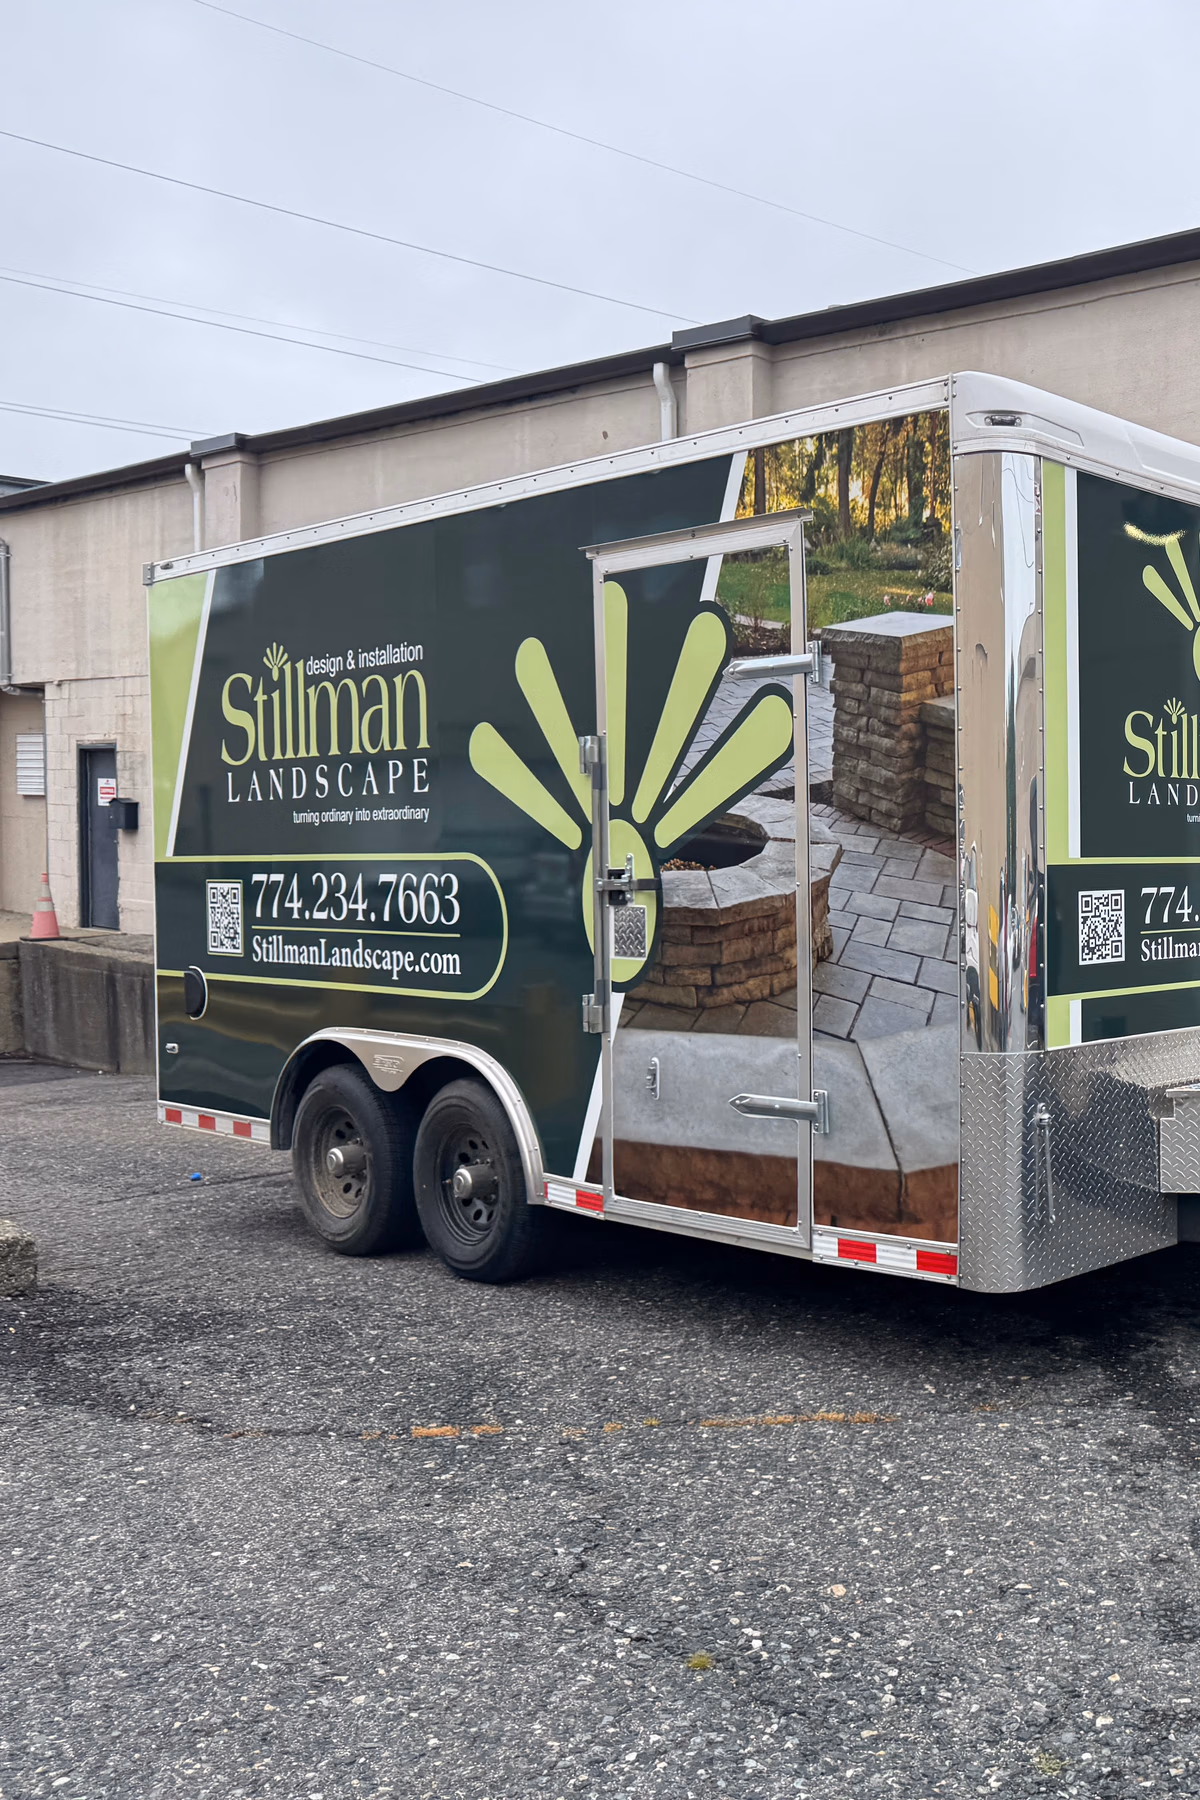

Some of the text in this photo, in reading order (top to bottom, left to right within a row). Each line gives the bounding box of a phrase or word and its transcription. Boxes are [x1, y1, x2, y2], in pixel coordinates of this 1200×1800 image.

[306, 641, 424, 677] design & installation
[221, 642, 431, 766] Stillman
[227, 758, 430, 803] LANDSCAPE
[292, 805, 430, 826] turning ordinary into extraordinary
[251, 872, 461, 925] 774.234.7663
[252, 934, 462, 980] StillmanLandscape.com
